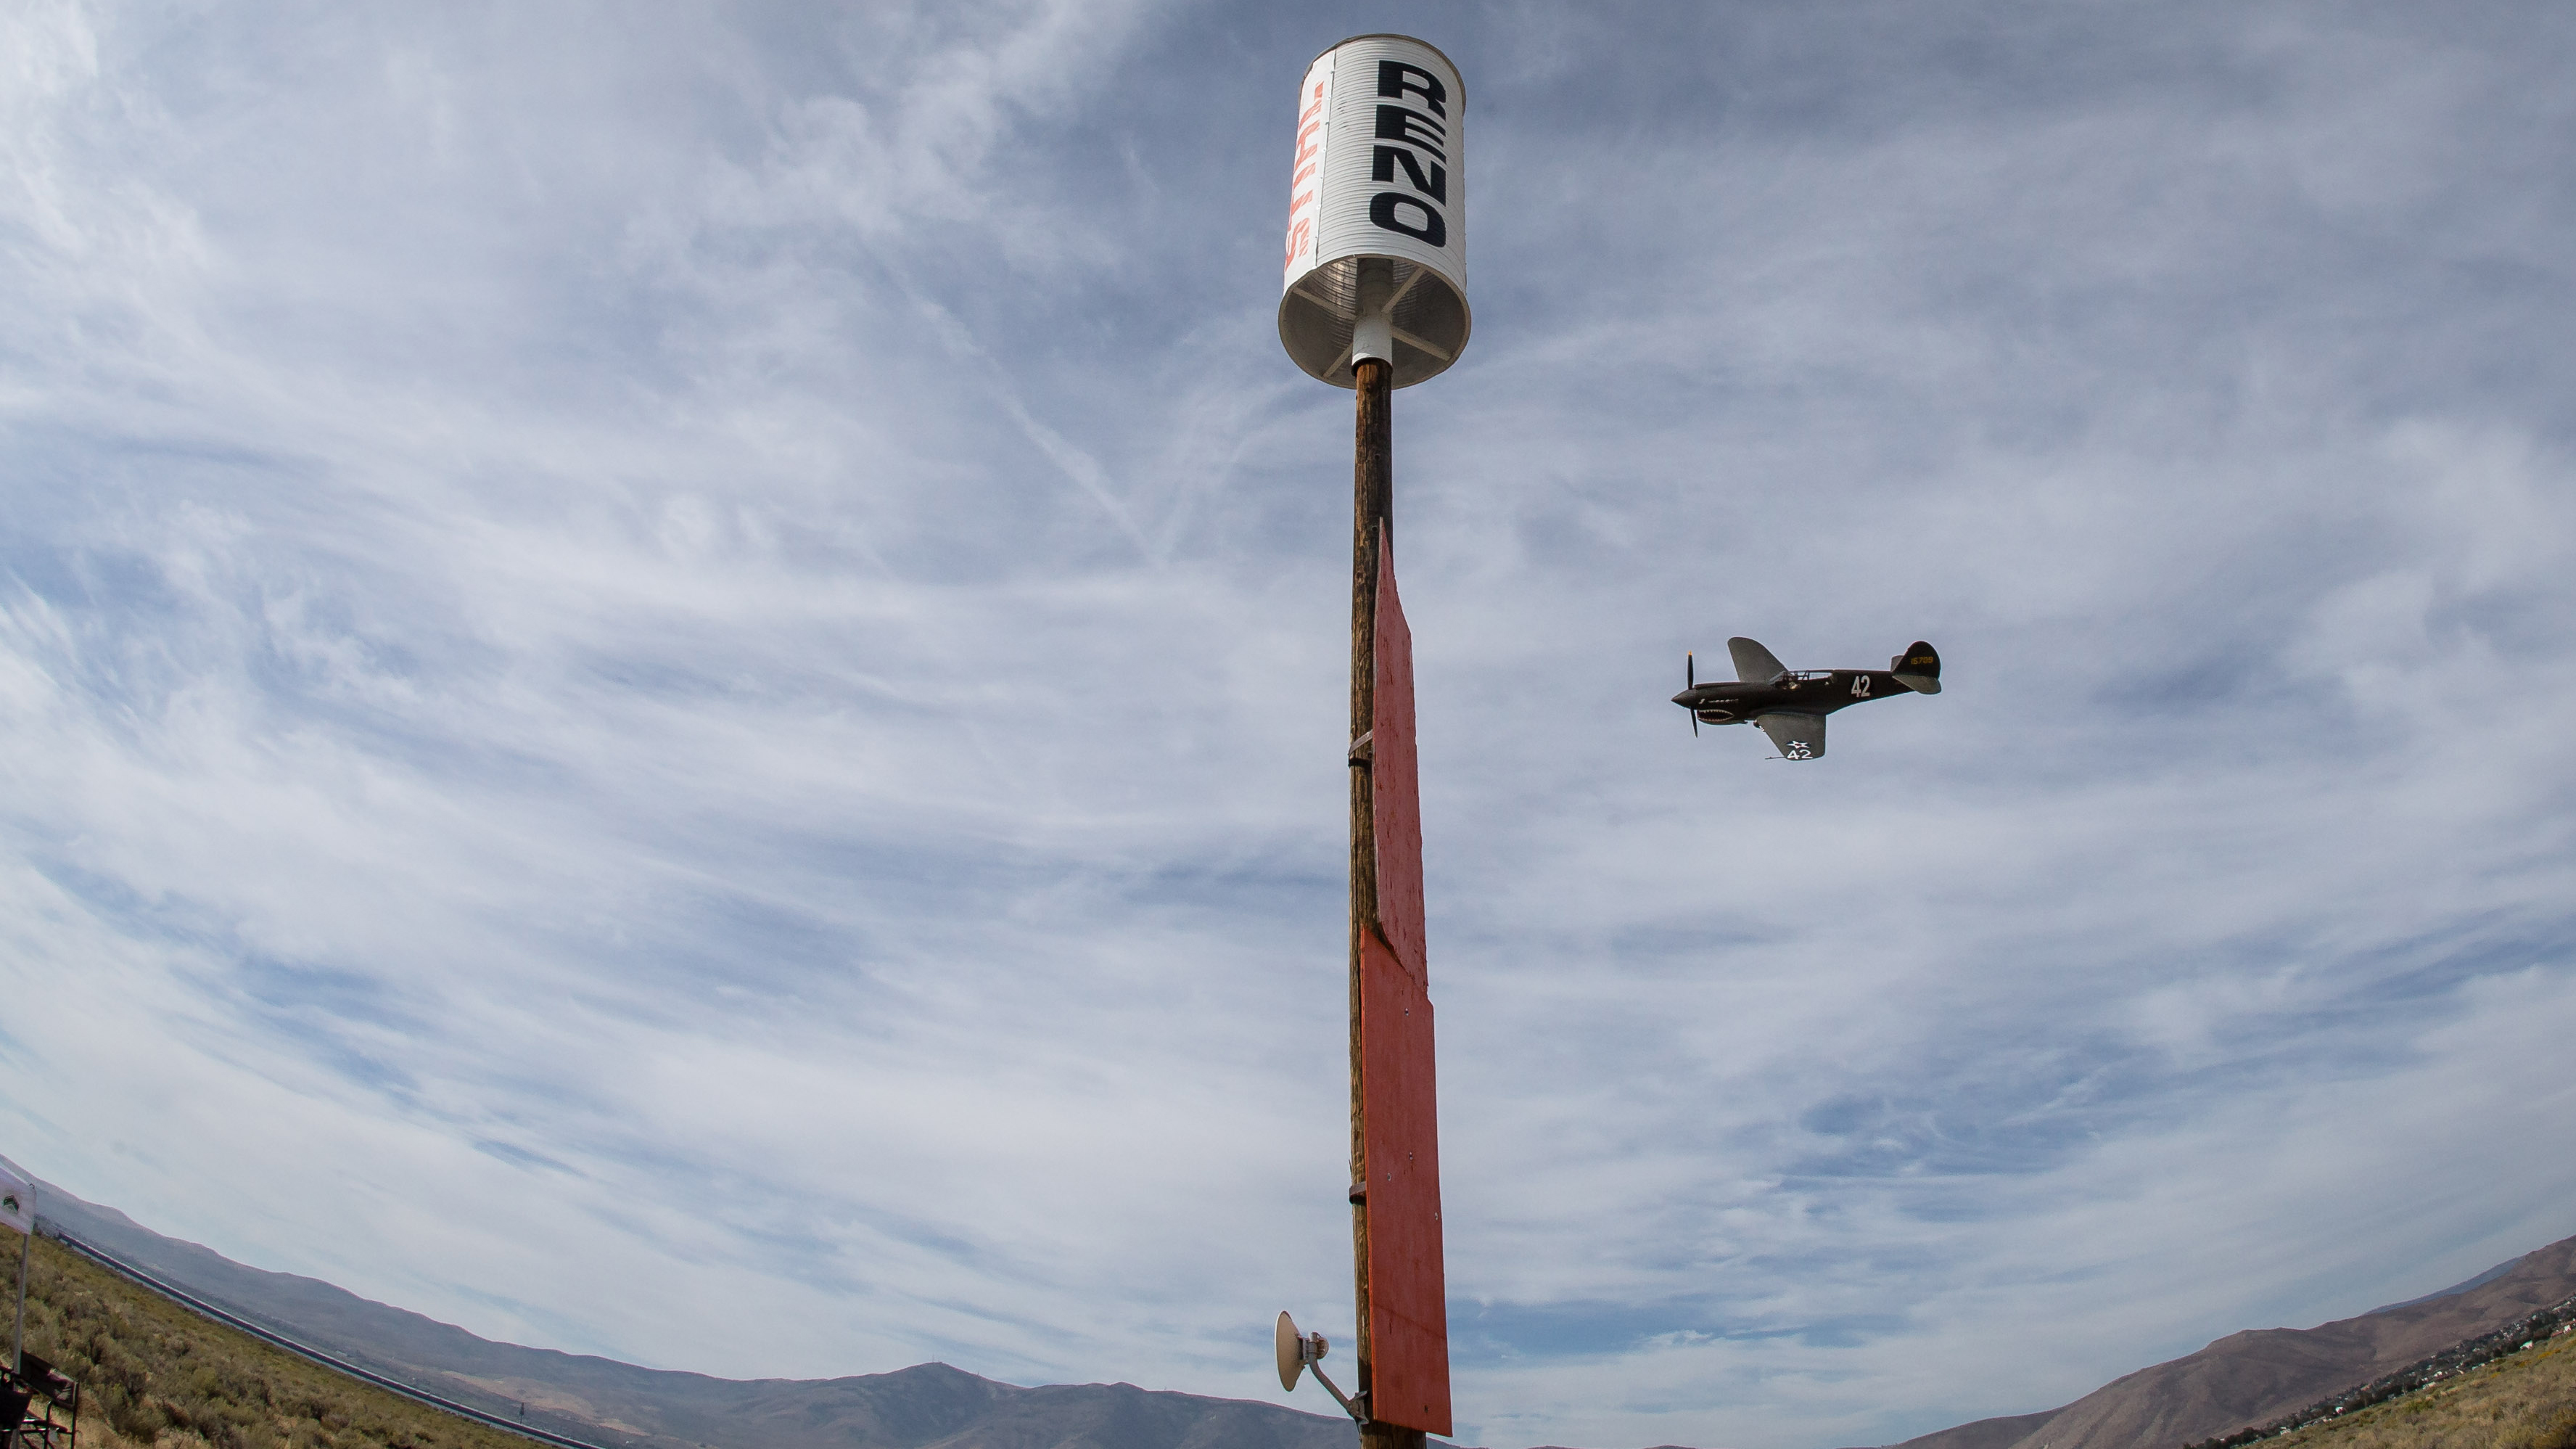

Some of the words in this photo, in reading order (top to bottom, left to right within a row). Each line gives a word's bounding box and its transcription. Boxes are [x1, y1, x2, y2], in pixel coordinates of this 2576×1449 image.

[1285, 81, 1324, 271] STIHL
[1370, 59, 1446, 247] RENO
[1851, 675, 1870, 697] 42
[1787, 750, 1814, 760] 42
